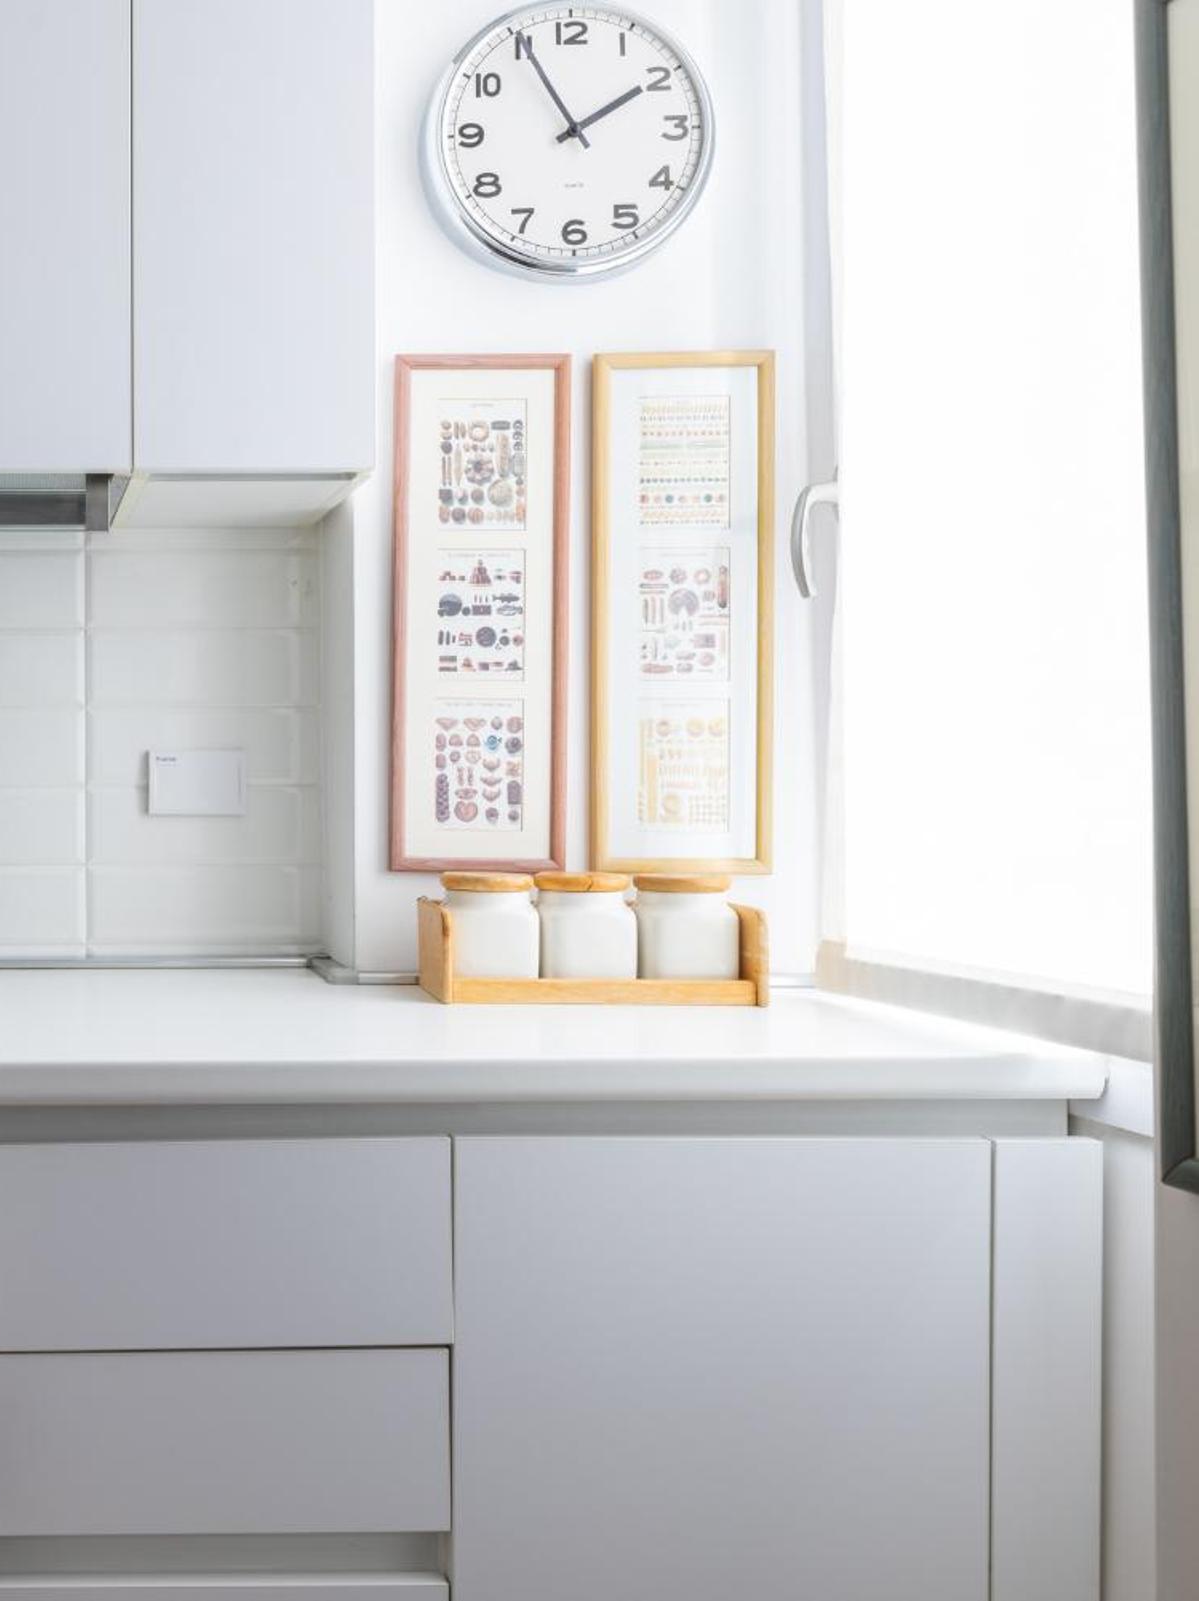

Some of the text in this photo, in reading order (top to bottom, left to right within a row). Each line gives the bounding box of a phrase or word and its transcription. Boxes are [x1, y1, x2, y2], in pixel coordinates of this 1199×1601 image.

[555, 21, 588, 45] 12
[619, 32, 627, 57] 1
[475, 72, 501, 98] 10
[646, 66, 672, 91] 2
[458, 123, 485, 148] 9
[661, 114, 689, 141] 3
[472, 172, 502, 198] 8
[648, 165, 674, 191] 4
[511, 207, 535, 234] 7
[611, 204, 640, 229] 5
[561, 219, 588, 245] 6
